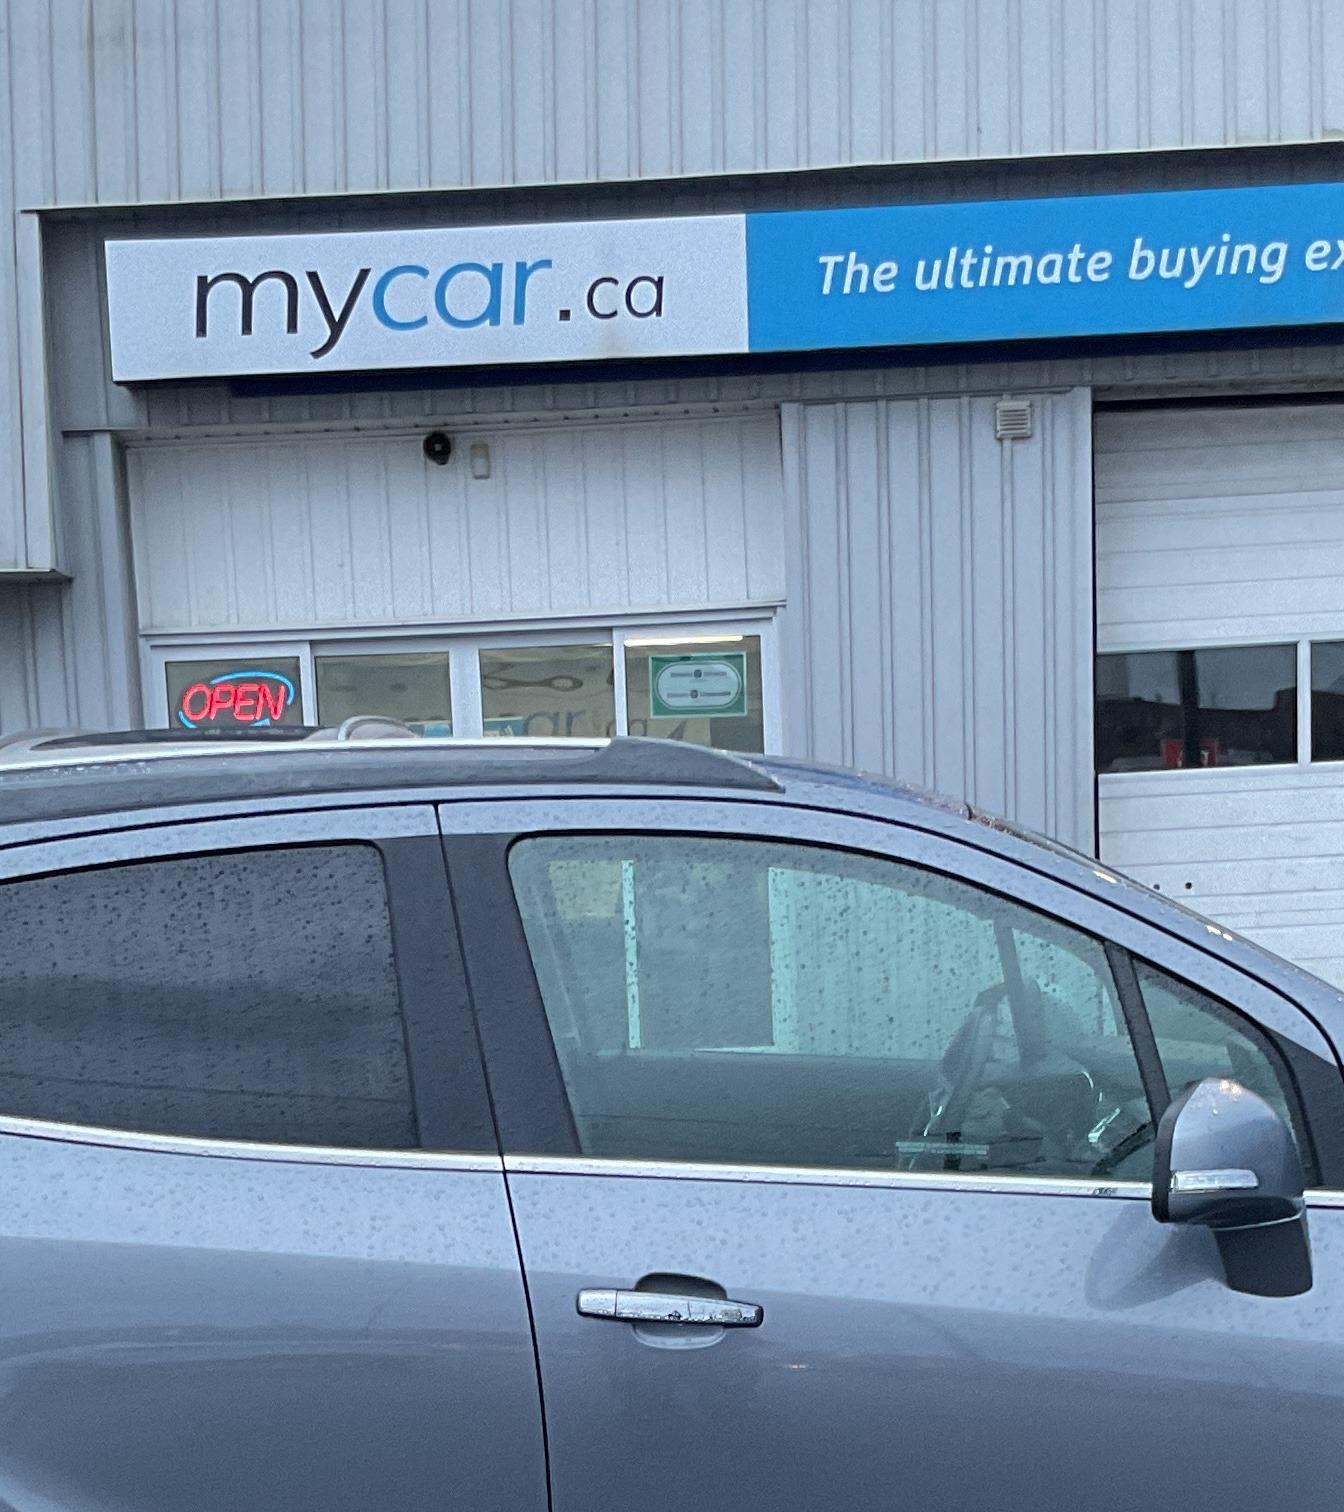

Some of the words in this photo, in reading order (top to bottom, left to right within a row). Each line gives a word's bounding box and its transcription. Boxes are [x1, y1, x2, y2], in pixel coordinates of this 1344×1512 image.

[818, 251, 899, 295] The
[914, 243, 1113, 291] ultimate
[1128, 233, 1289, 289] buying
[182, 683, 285, 721] OPEN
